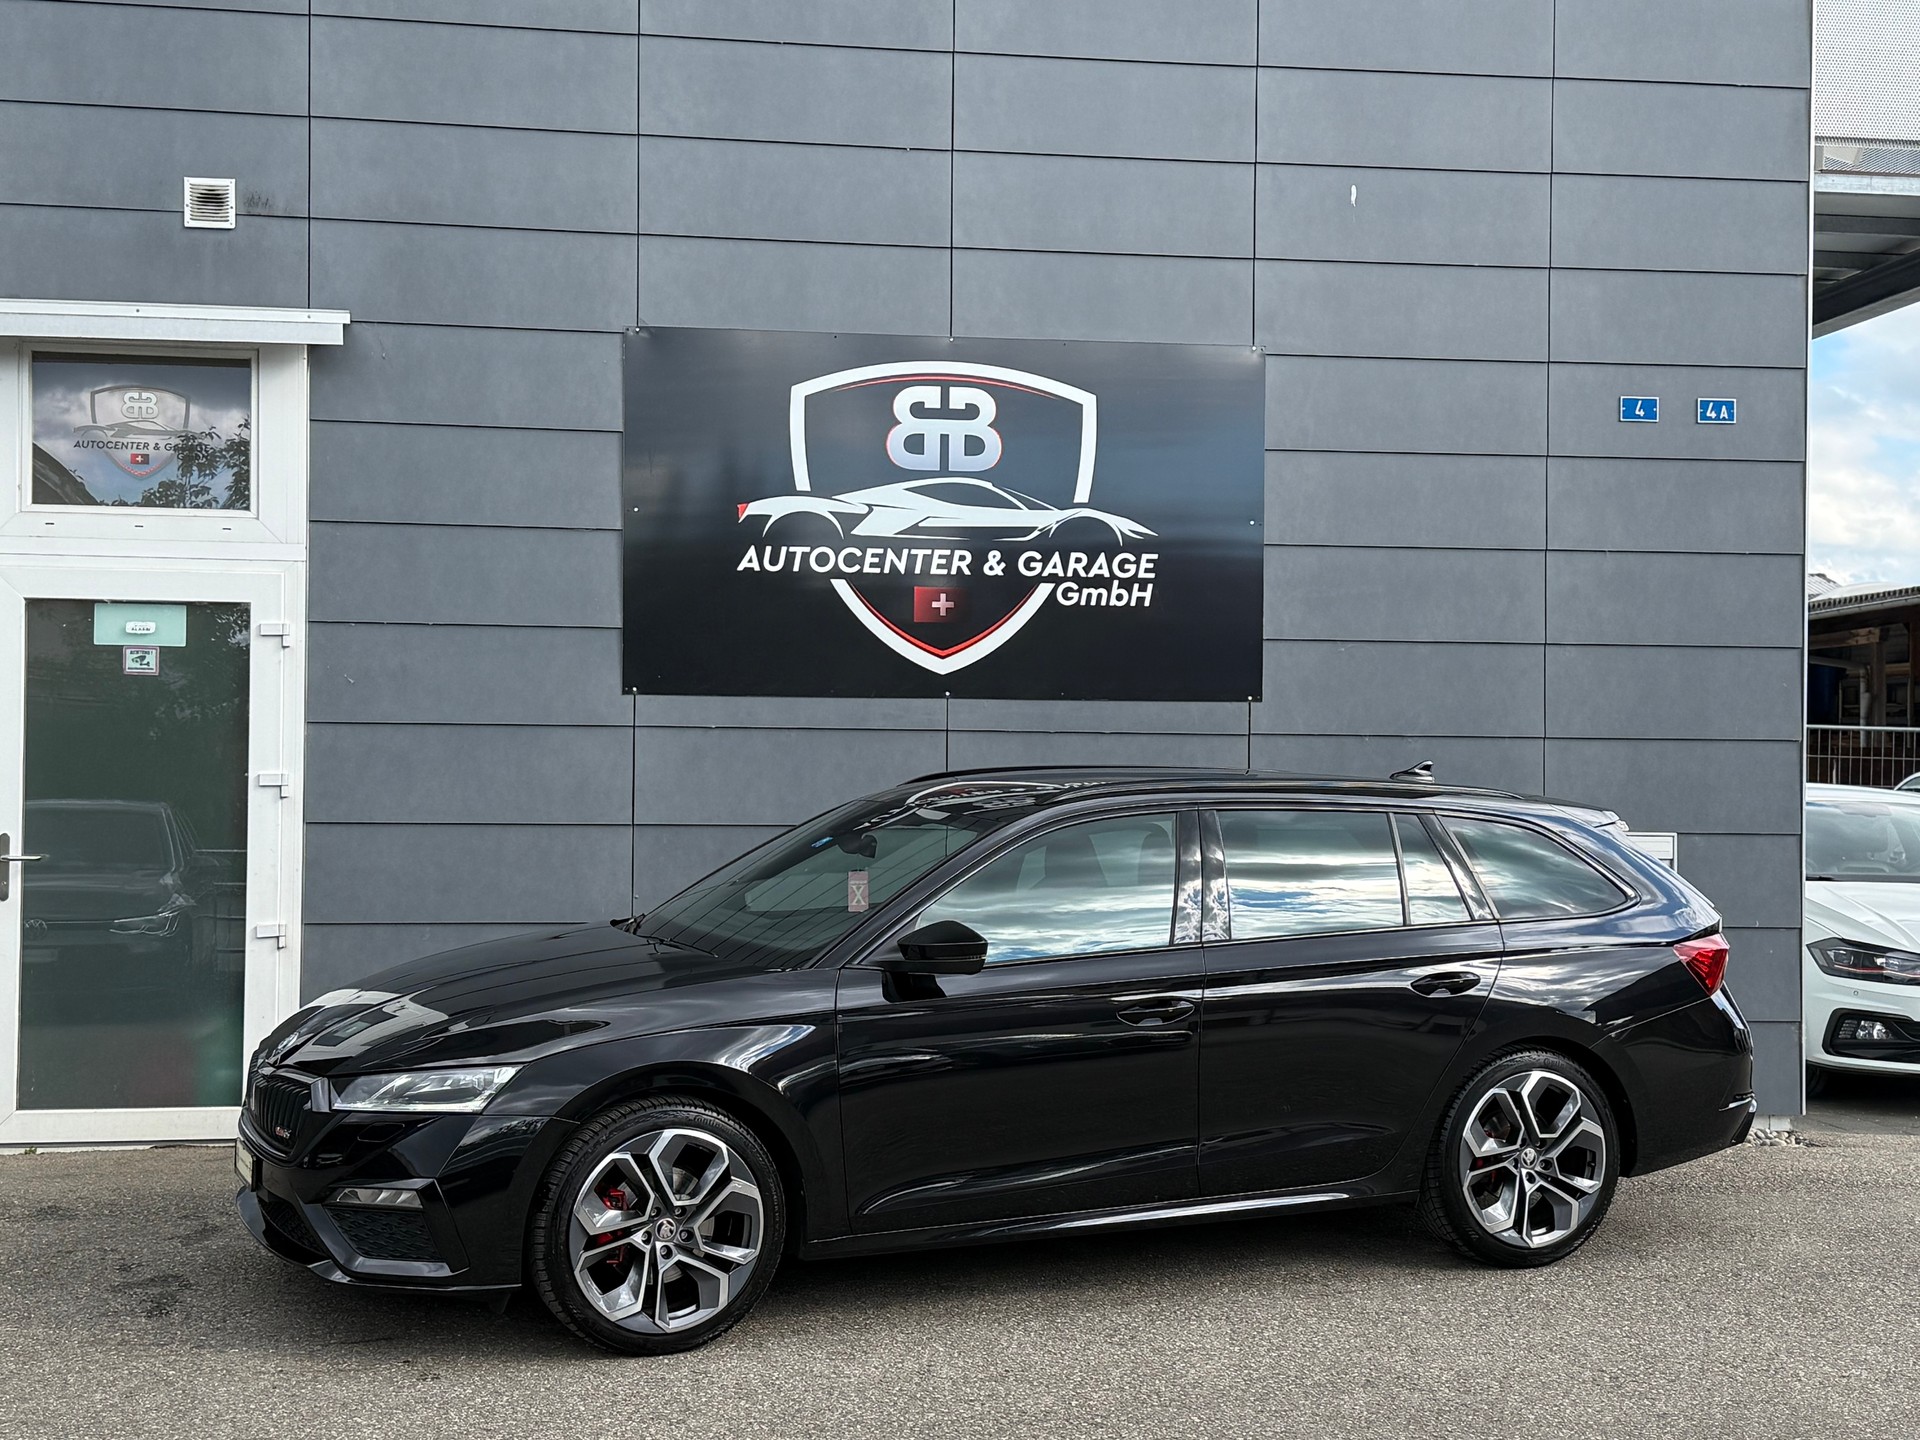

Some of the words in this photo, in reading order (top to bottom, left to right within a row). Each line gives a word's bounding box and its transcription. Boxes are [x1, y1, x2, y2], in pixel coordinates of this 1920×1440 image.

[1635, 400, 1645, 417] 4
[73, 440, 150, 451] AUTOCENTER
[153, 442, 161, 451] &
[737, 545, 971, 575] AUTOCENTER
[983, 550, 1006, 576] &
[1017, 551, 1159, 579] GARAGE
[1056, 580, 1153, 607] GmbH
